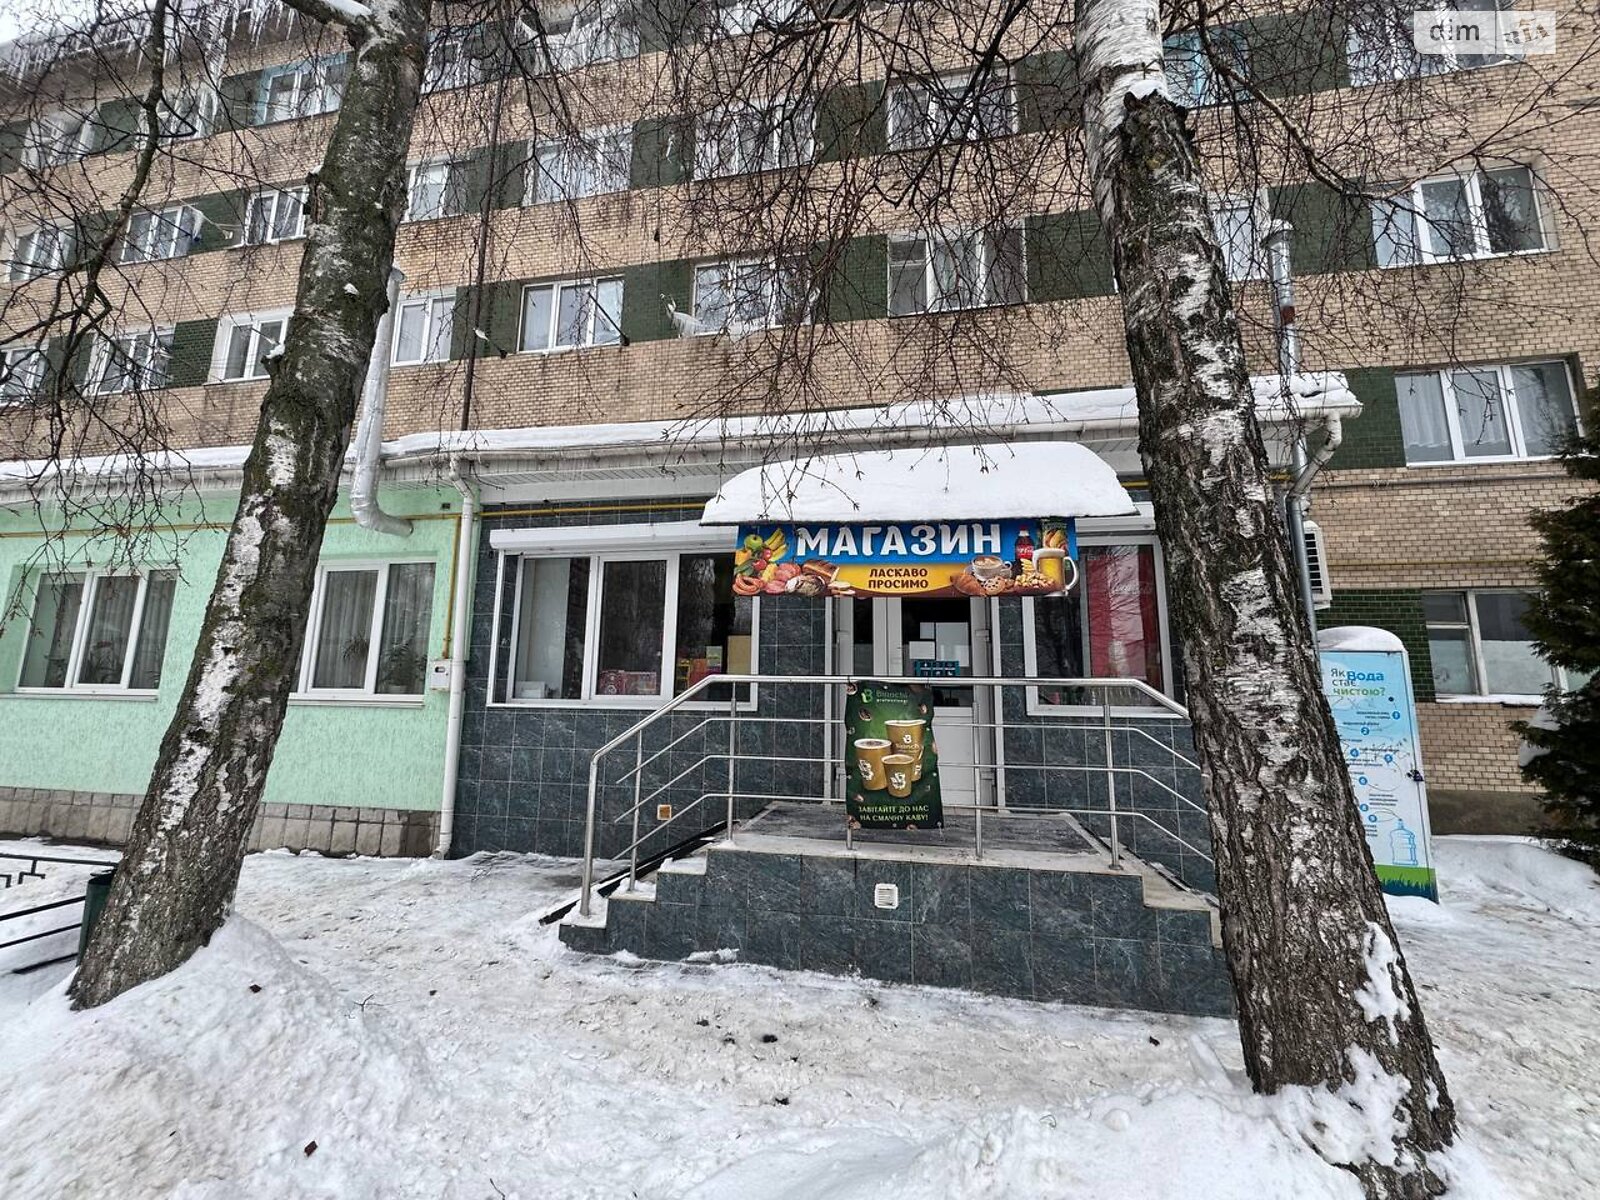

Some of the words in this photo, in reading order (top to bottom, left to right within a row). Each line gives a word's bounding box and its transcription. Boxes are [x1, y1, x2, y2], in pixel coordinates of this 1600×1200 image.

[796, 523, 1001, 557] МАГАЗИН
[869, 568, 928, 578] ЛАСКАВО
[868, 579, 929, 589] ПРОСИМО
[1330, 668, 1346, 678] Як
[1331, 679, 1357, 687] стає
[1333, 686, 1386, 696] чистою?
[898, 804, 911, 814] ДО
[912, 803, 929, 812] НАС
